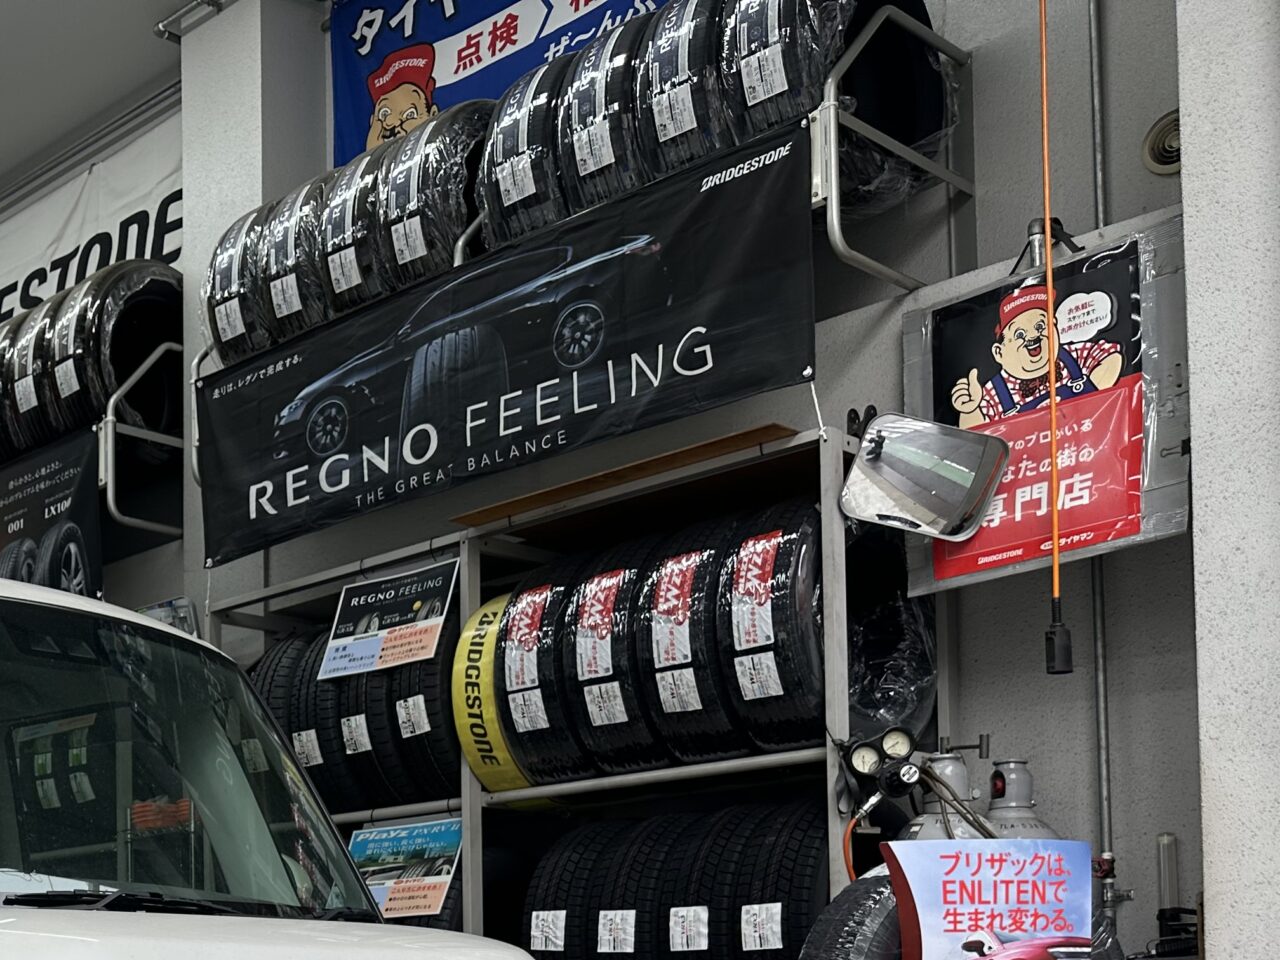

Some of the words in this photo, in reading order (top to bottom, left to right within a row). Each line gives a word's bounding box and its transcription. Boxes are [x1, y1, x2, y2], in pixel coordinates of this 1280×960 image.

[453, 12, 519, 75] 点検
[374, 58, 429, 88] BRIDGESTONE
[700, 142, 793, 193] BRIDGESTONE
[248, 423, 439, 521] REGNO
[464, 326, 714, 448] FEELING
[355, 487, 386, 508] THE
[467, 429, 568, 472] BALANCE
[7, 518, 24, 534] 001
[977, 548, 1023, 565] BRIDGESTONE
[351, 589, 395, 607] REGNO
[398, 576, 443, 597] FEELING
[464, 611, 501, 767] BRIDGESTONE
[357, 829, 410, 842] Playz
[939, 850, 1072, 877] ブリザックは、
[943, 907, 1074, 933] 生まれ変わる。
